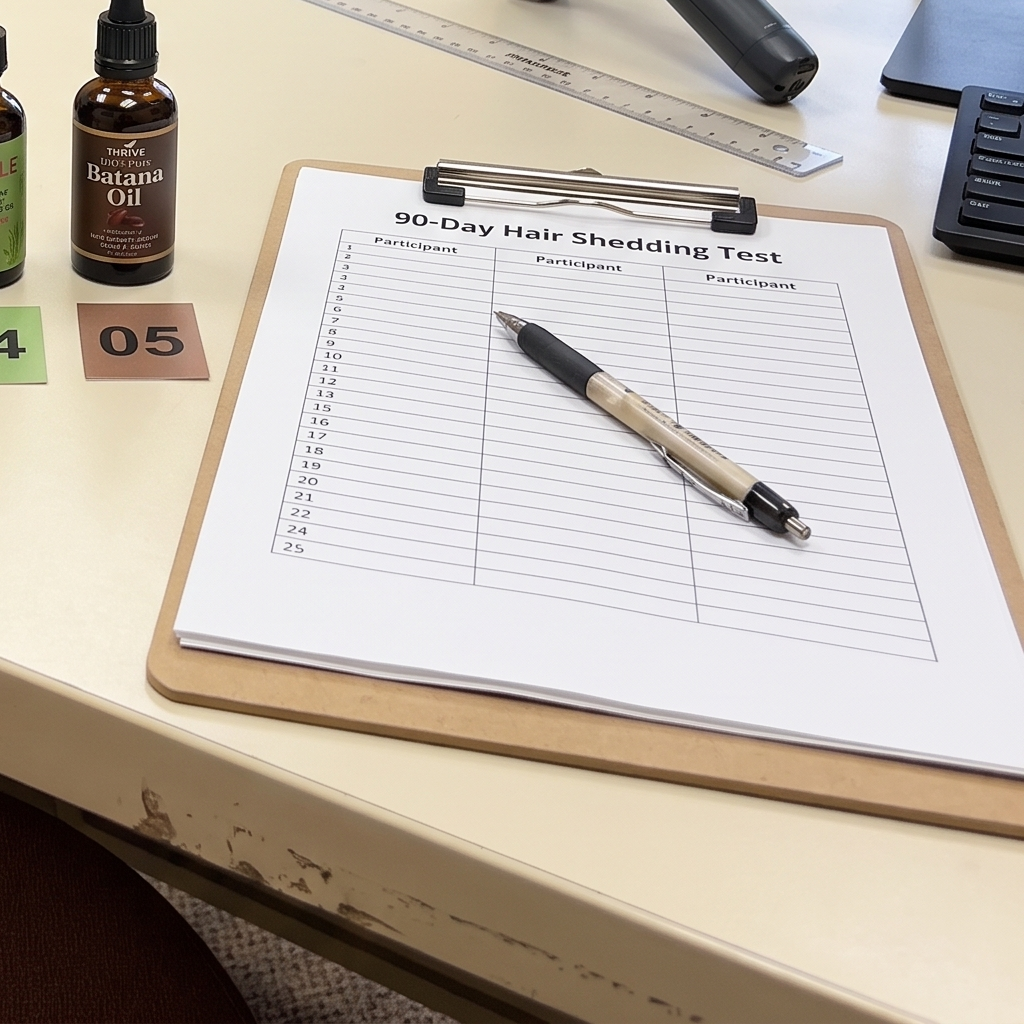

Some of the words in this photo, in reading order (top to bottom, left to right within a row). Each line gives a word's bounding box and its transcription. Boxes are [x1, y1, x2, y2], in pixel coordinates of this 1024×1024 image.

[106, 147, 146, 157] THRIVE
[86, 161, 164, 187] Batana
[106, 187, 142, 207] Oil
[394, 211, 495, 238] 90-Day
[503, 224, 565, 243] Hair
[571, 232, 710, 261] Shedding
[717, 245, 784, 265] Test
[374, 237, 459, 254] Participant
[536, 255, 624, 272] Participant
[705, 274, 798, 291] Participant
[98, 325, 186, 357] 05
[326, 339, 335, 347] 9
[323, 351, 343, 361] 10
[318, 376, 337, 386] 12
[316, 389, 335, 399] 13
[312, 403, 332, 413] 15
[310, 416, 330, 427] 16
[307, 430, 327, 440] 17
[305, 445, 324, 456] 18
[301, 460, 322, 471] 19
[297, 475, 319, 486] 20
[293, 491, 314, 503] 21
[290, 507, 311, 520] 22
[286, 524, 308, 536] 24
[282, 541, 305, 554] 25
